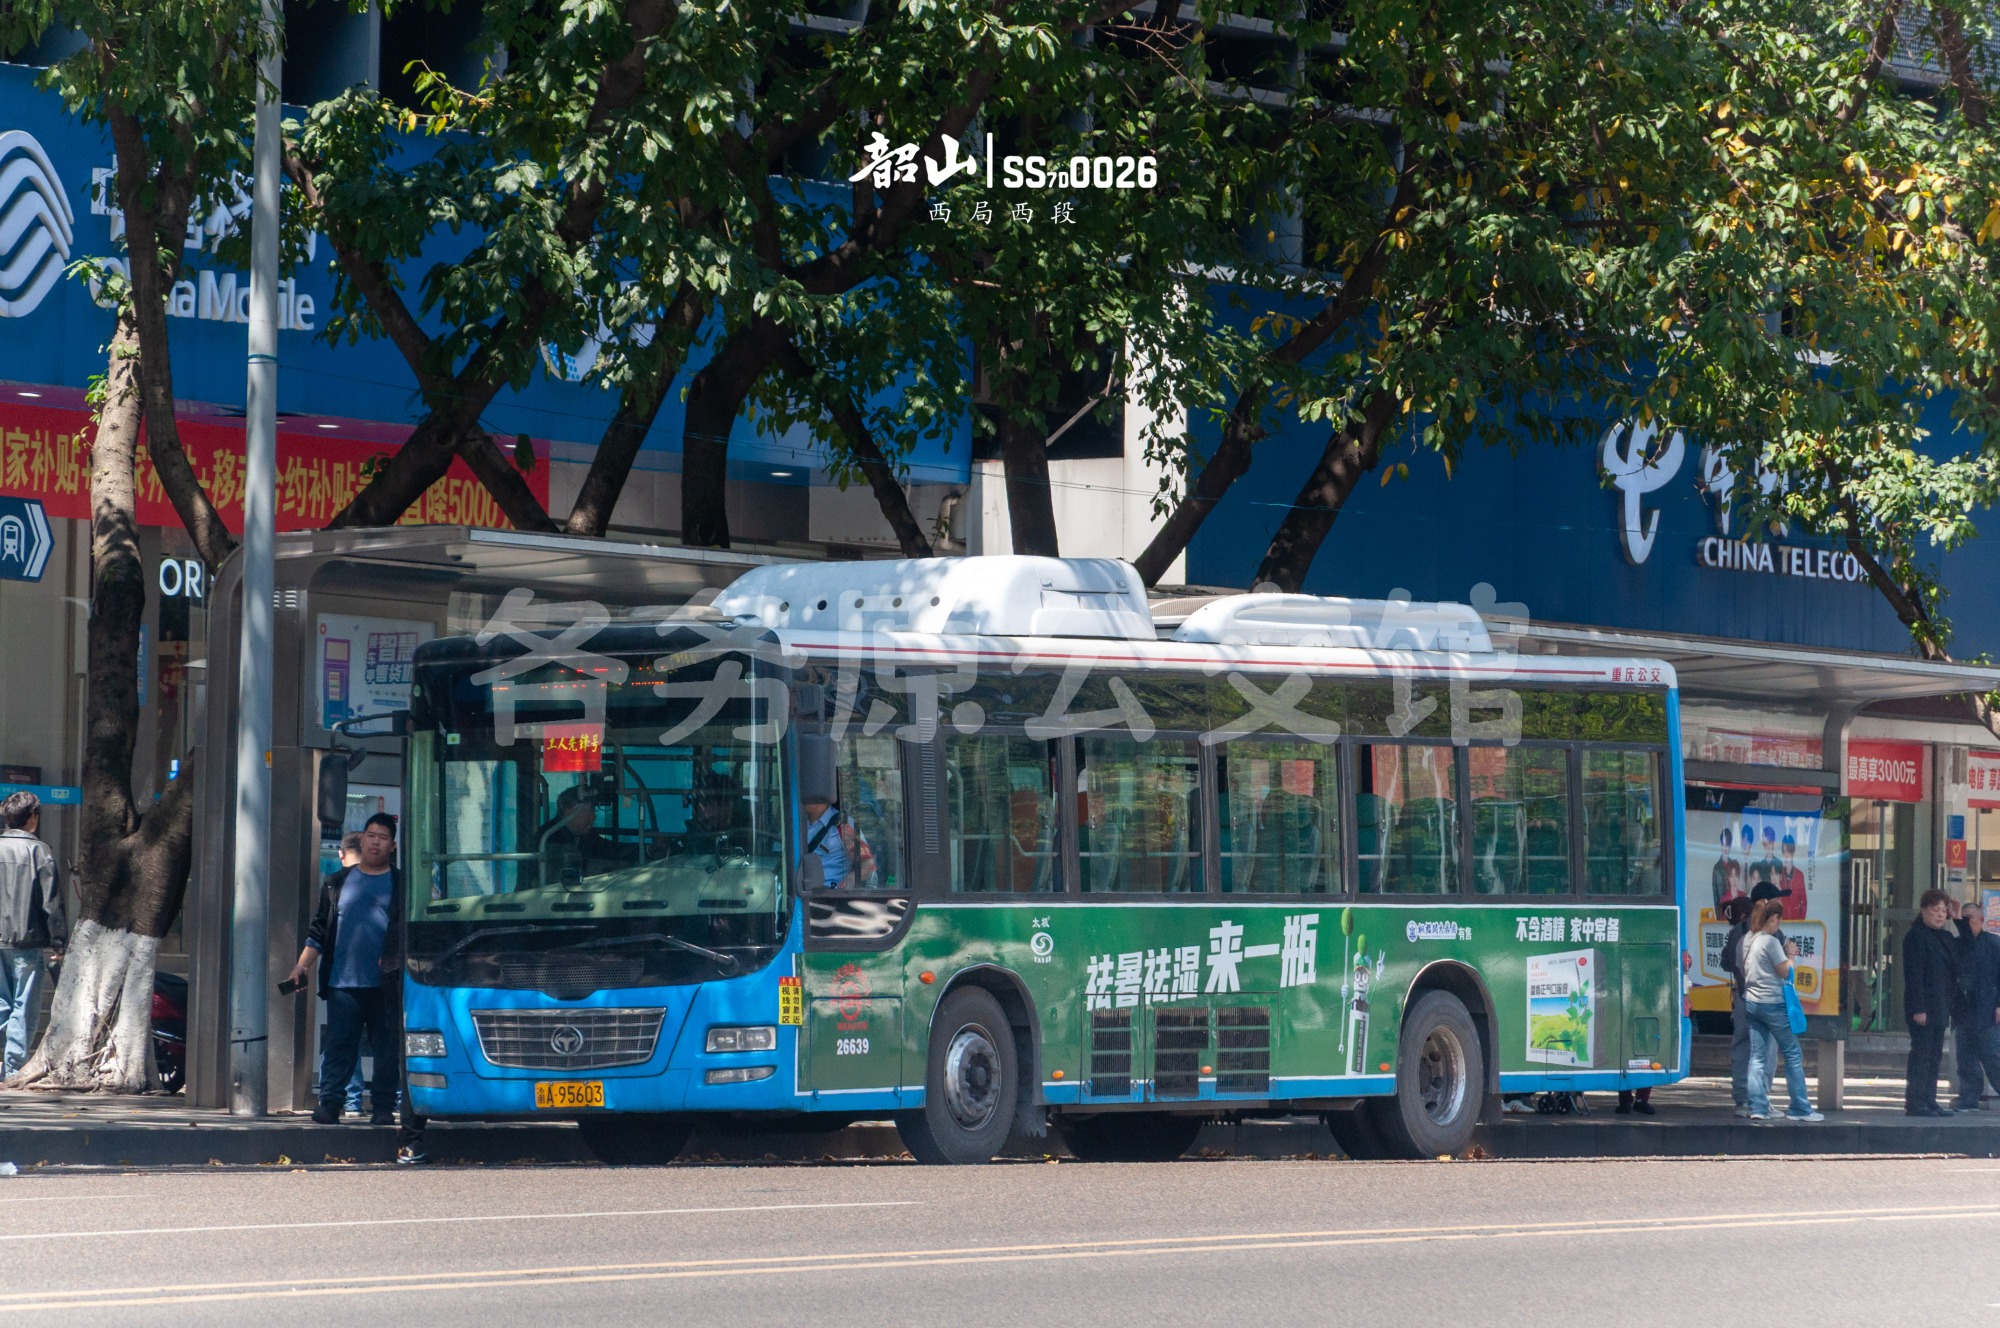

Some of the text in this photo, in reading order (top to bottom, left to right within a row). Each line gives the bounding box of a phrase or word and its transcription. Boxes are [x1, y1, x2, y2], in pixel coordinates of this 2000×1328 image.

[199, 269, 315, 331] Moile
[1704, 536, 1775, 574] CHINA
[1612, 667, 1661, 683] 重庆公交
[547, 733, 599, 752] 工人先锋号
[1848, 755, 1917, 785] 最高享3000元
[1516, 916, 1620, 942] 不含酒精 家中常备
[836, 1038, 869, 1055] 26639
